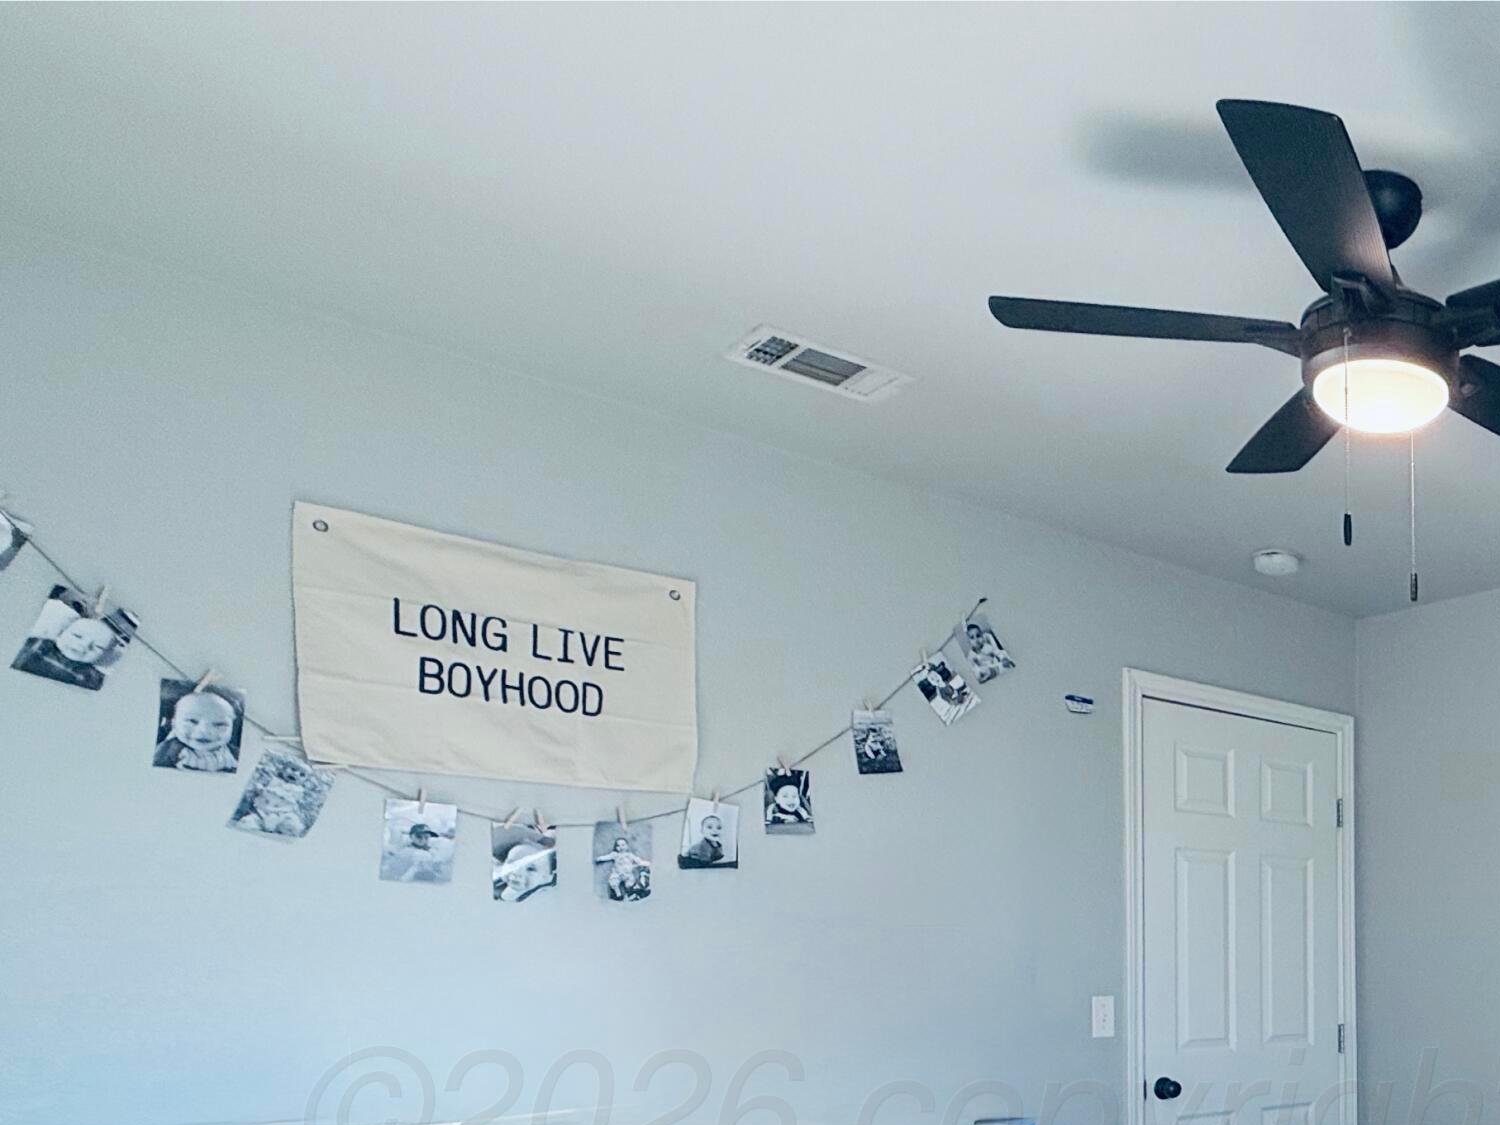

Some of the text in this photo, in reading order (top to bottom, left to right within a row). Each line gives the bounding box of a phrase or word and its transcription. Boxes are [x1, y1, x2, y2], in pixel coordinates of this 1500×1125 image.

[393, 597, 625, 671] LONG LIVE
[418, 657, 604, 717] BOYHOOD
